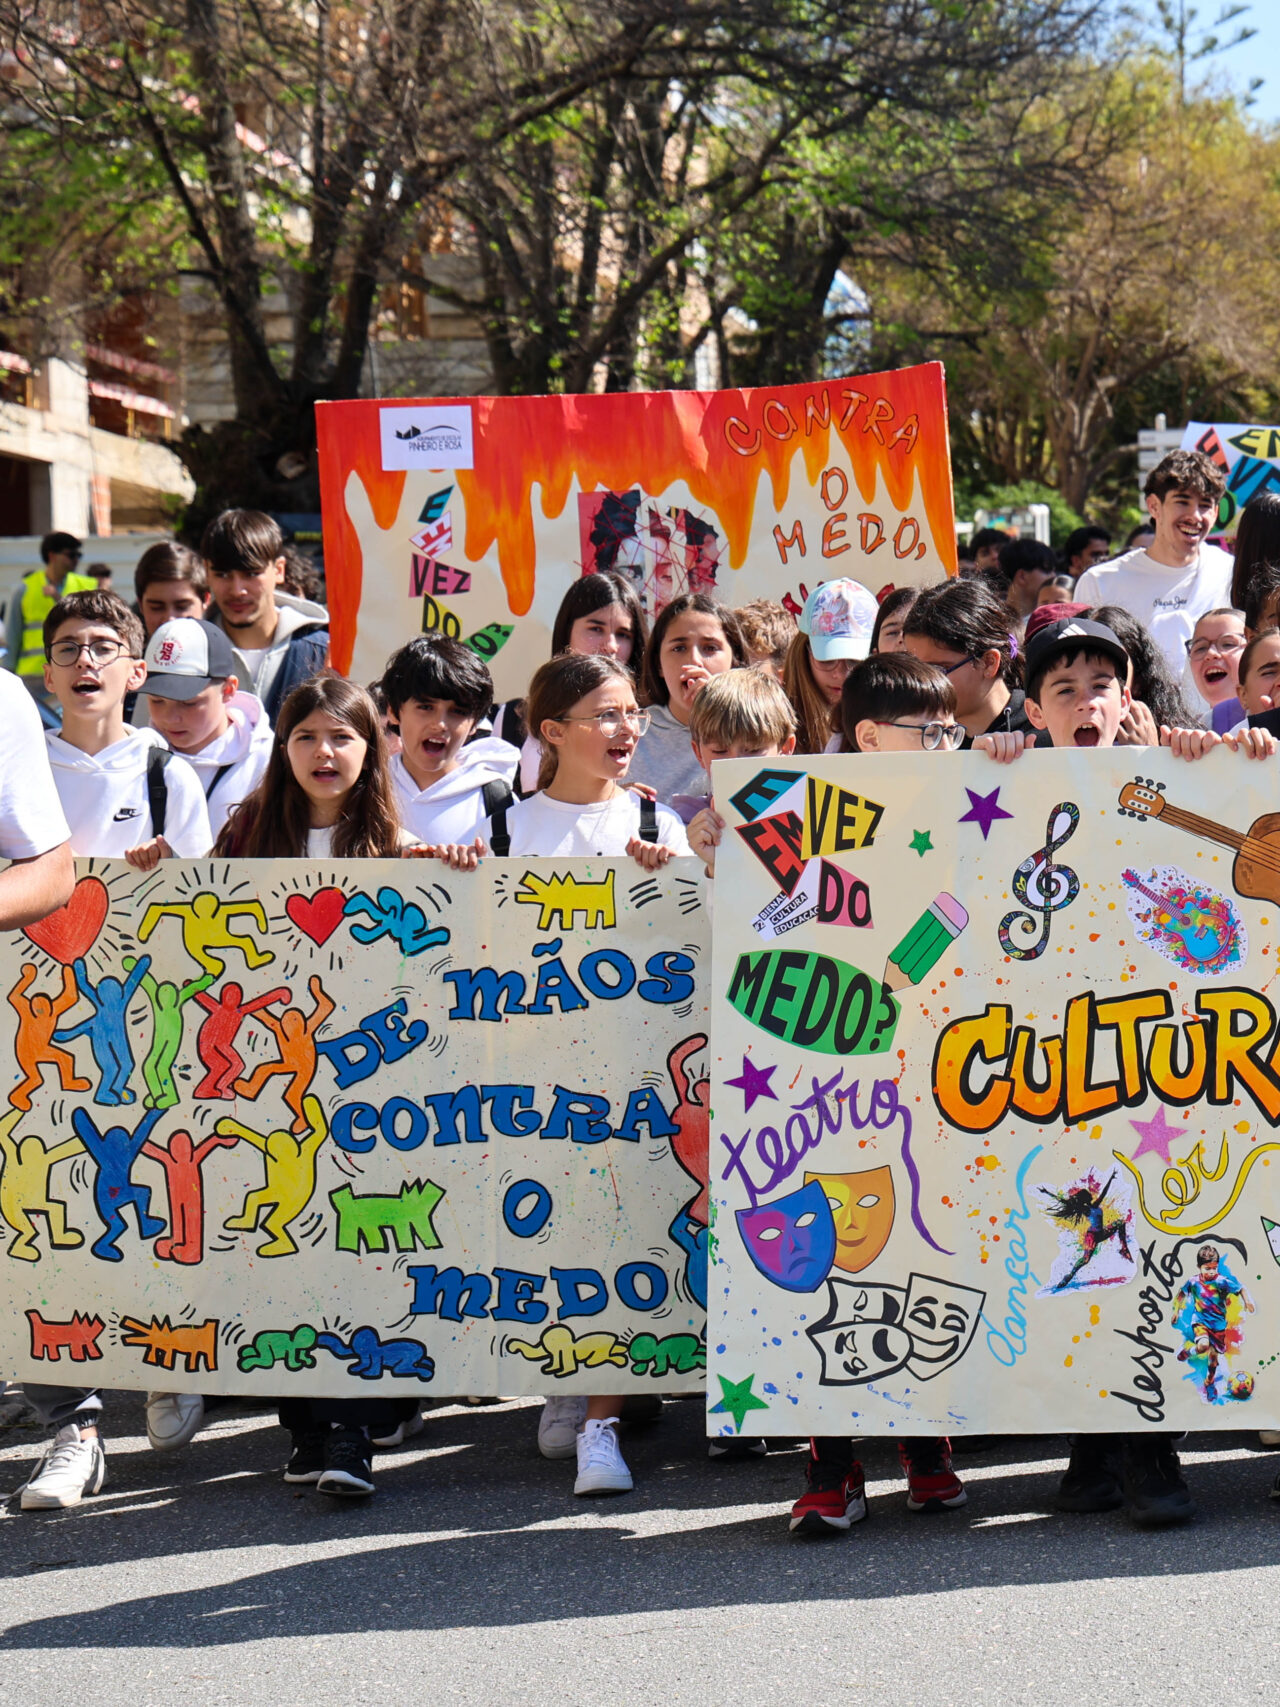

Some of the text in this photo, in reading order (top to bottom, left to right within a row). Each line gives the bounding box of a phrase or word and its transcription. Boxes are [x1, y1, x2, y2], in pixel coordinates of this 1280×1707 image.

[724, 389, 919, 457] CONTRA
[418, 485, 454, 525] E
[820, 467, 848, 511] O
[773, 513, 927, 564] MEDO,
[412, 553, 471, 597] VEZ
[422, 593, 461, 642] DO
[729, 770, 807, 822] E
[735, 777, 885, 897] EM VEZ
[760, 893, 787, 919] BIENAL
[771, 894, 807, 924] CULTURA
[818, 859, 872, 927] DO
[317, 938, 697, 1090] DE MÃOS
[728, 951, 897, 1055] MEDO?
[330, 1085, 682, 1155] CONTRA
[721, 1066, 905, 1220] teatro
[502, 1179, 552, 1238] O
[986, 1150, 1040, 1367] dançar
[406, 1261, 670, 1323] MEDO
[1109, 1236, 1200, 1423] desporto
